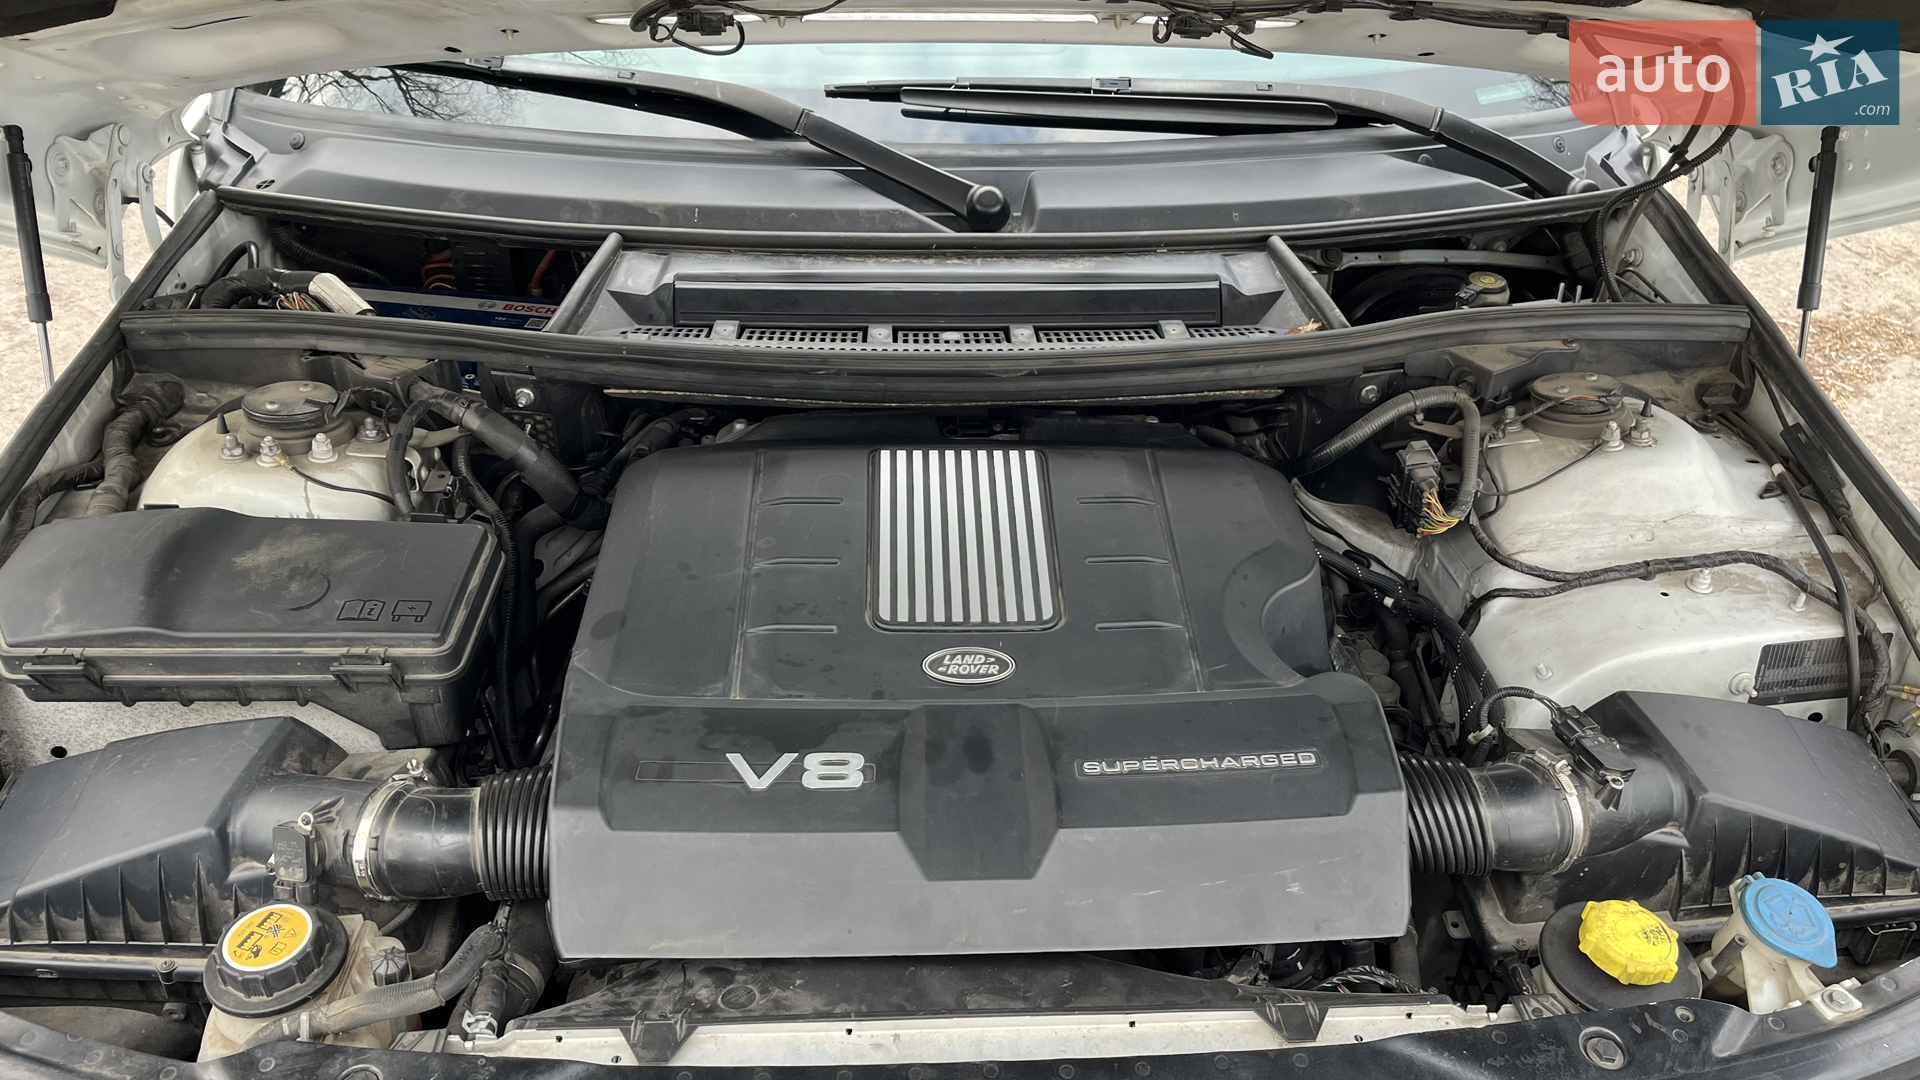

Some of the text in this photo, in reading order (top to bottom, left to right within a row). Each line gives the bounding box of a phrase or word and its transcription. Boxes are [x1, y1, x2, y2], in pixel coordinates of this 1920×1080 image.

[502, 303, 558, 315] BOSCH
[943, 654, 986, 665] LAND
[946, 664, 1000, 675] ROVER
[1082, 752, 1317, 775] SUPERCHARGED
[725, 752, 865, 791] V8
